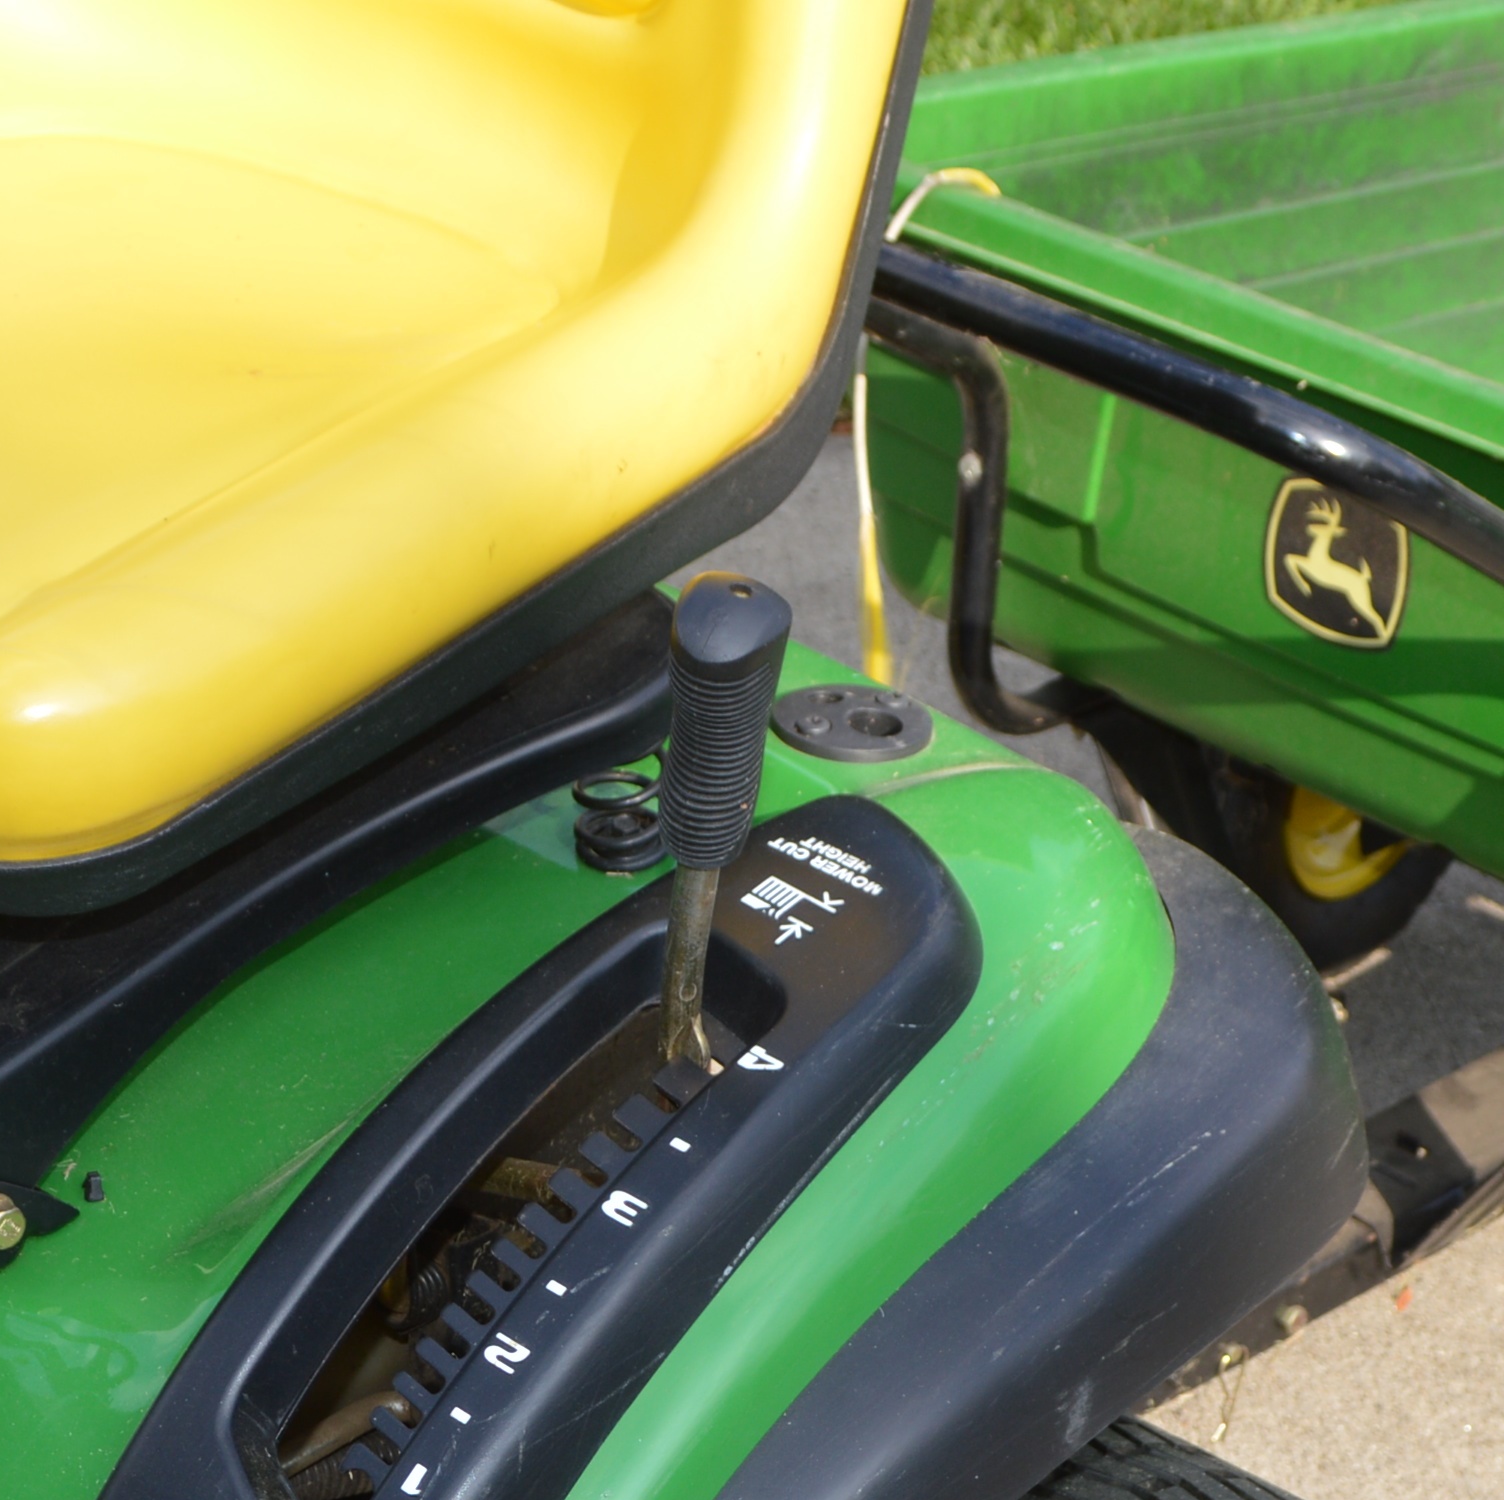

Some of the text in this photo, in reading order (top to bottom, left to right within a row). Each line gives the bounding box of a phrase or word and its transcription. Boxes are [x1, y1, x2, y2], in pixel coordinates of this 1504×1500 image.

[767, 837, 884, 896] MOWER CUT
[799, 836, 872, 874] HEIGHT
[737, 1045, 785, 1071] 4
[601, 1190, 649, 1227] 3
[484, 1332, 531, 1375] 2
[400, 1463, 427, 1496] 1
